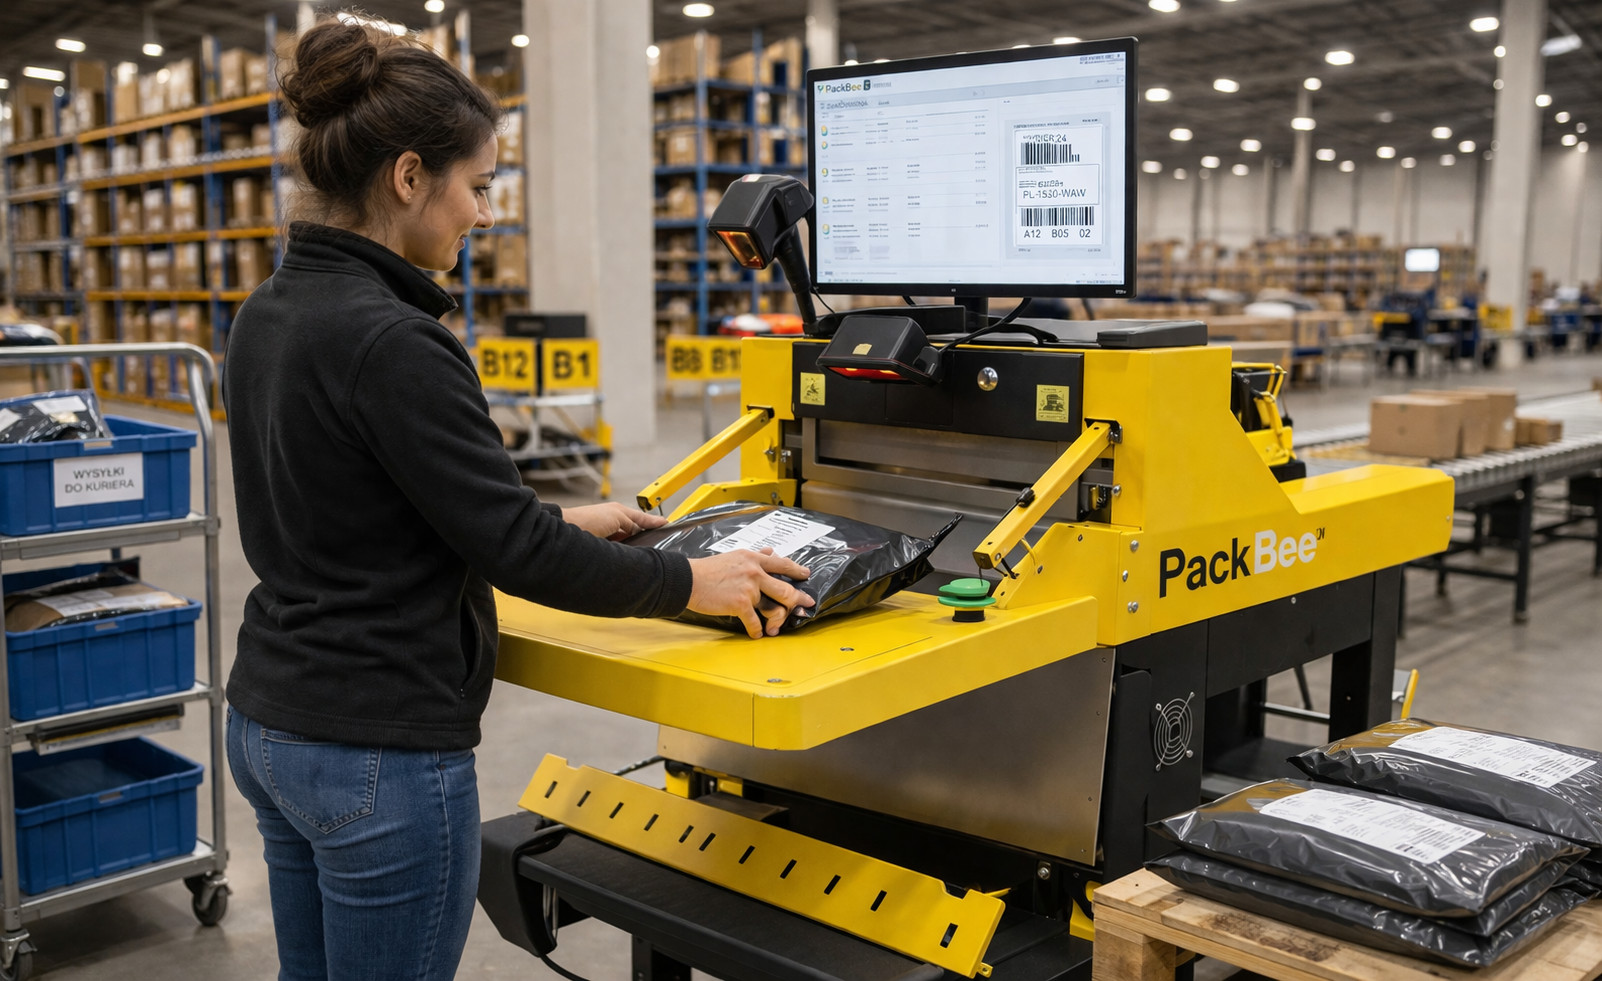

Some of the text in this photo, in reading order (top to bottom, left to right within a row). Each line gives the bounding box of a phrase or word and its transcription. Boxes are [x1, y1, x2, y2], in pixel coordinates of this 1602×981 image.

[825, 83, 862, 93] PackBee
[1024, 229, 1041, 238] A12
[1079, 228, 1091, 238] 02
[482, 349, 529, 379] B12
[553, 350, 591, 379] B1
[73, 467, 125, 480] WYSYŁKI
[65, 479, 135, 494] DO KURIERA
[1159, 529, 1318, 599] PackBee
